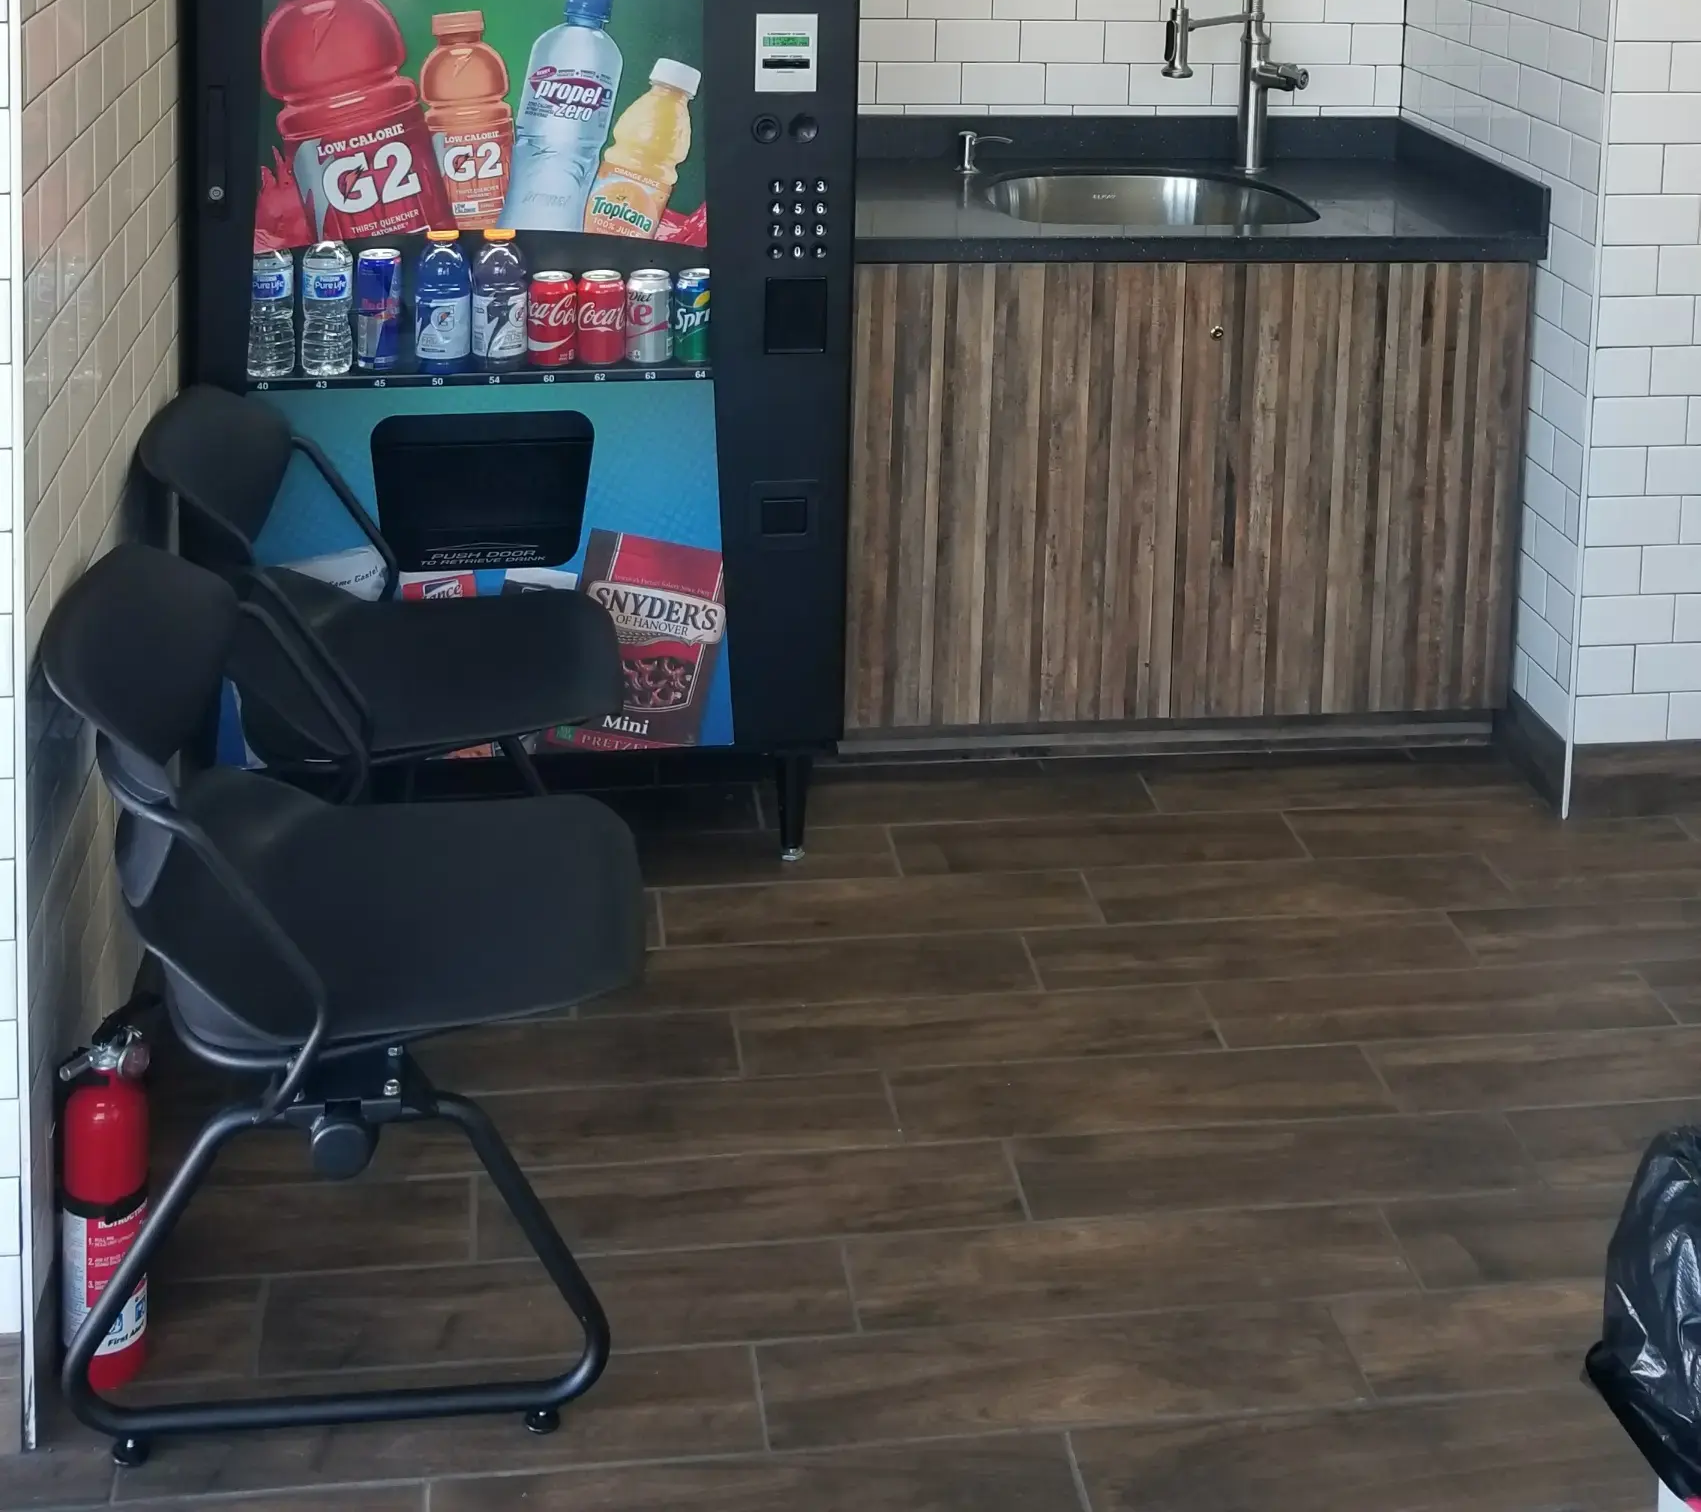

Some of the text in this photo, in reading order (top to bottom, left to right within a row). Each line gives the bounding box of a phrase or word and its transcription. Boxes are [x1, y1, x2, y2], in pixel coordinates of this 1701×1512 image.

[534, 80, 603, 106] propel
[554, 103, 593, 122] zero
[317, 123, 405, 157] LOW CALORIE
[444, 131, 500, 144] LOW CALORIE
[444, 141, 504, 182] G2
[322, 141, 422, 214] G2
[614, 167, 660, 188] ORANGE JUICE
[774, 180, 825, 192] 1 2 3
[592, 196, 653, 232] Tropicana
[772, 202, 824, 214] 4 5 6
[351, 209, 419, 234] THIRST QUENCHER
[594, 217, 615, 231] 100%
[773, 224, 823, 236] 7 8 9
[794, 246, 801, 257] 0
[253, 279, 284, 291] Pure Life
[315, 279, 347, 291] Pure Life
[629, 291, 653, 302] Diet
[675, 308, 711, 333] Spri
[488, 376, 500, 384] 54
[594, 373, 606, 381] 62
[645, 371, 656, 379] 63
[695, 370, 706, 378] 64
[257, 382, 269, 390] 40
[315, 381, 327, 389] 43
[432, 377, 443, 385] 50
[431, 550, 536, 560] PUSH DOOR
[423, 583, 463, 599] ance
[596, 588, 718, 631] SNYDER'S
[616, 614, 688, 636] OF HANOVER
[602, 715, 649, 735] Mini
[581, 734, 649, 750] PRETZE
[108, 1333, 129, 1347] First
